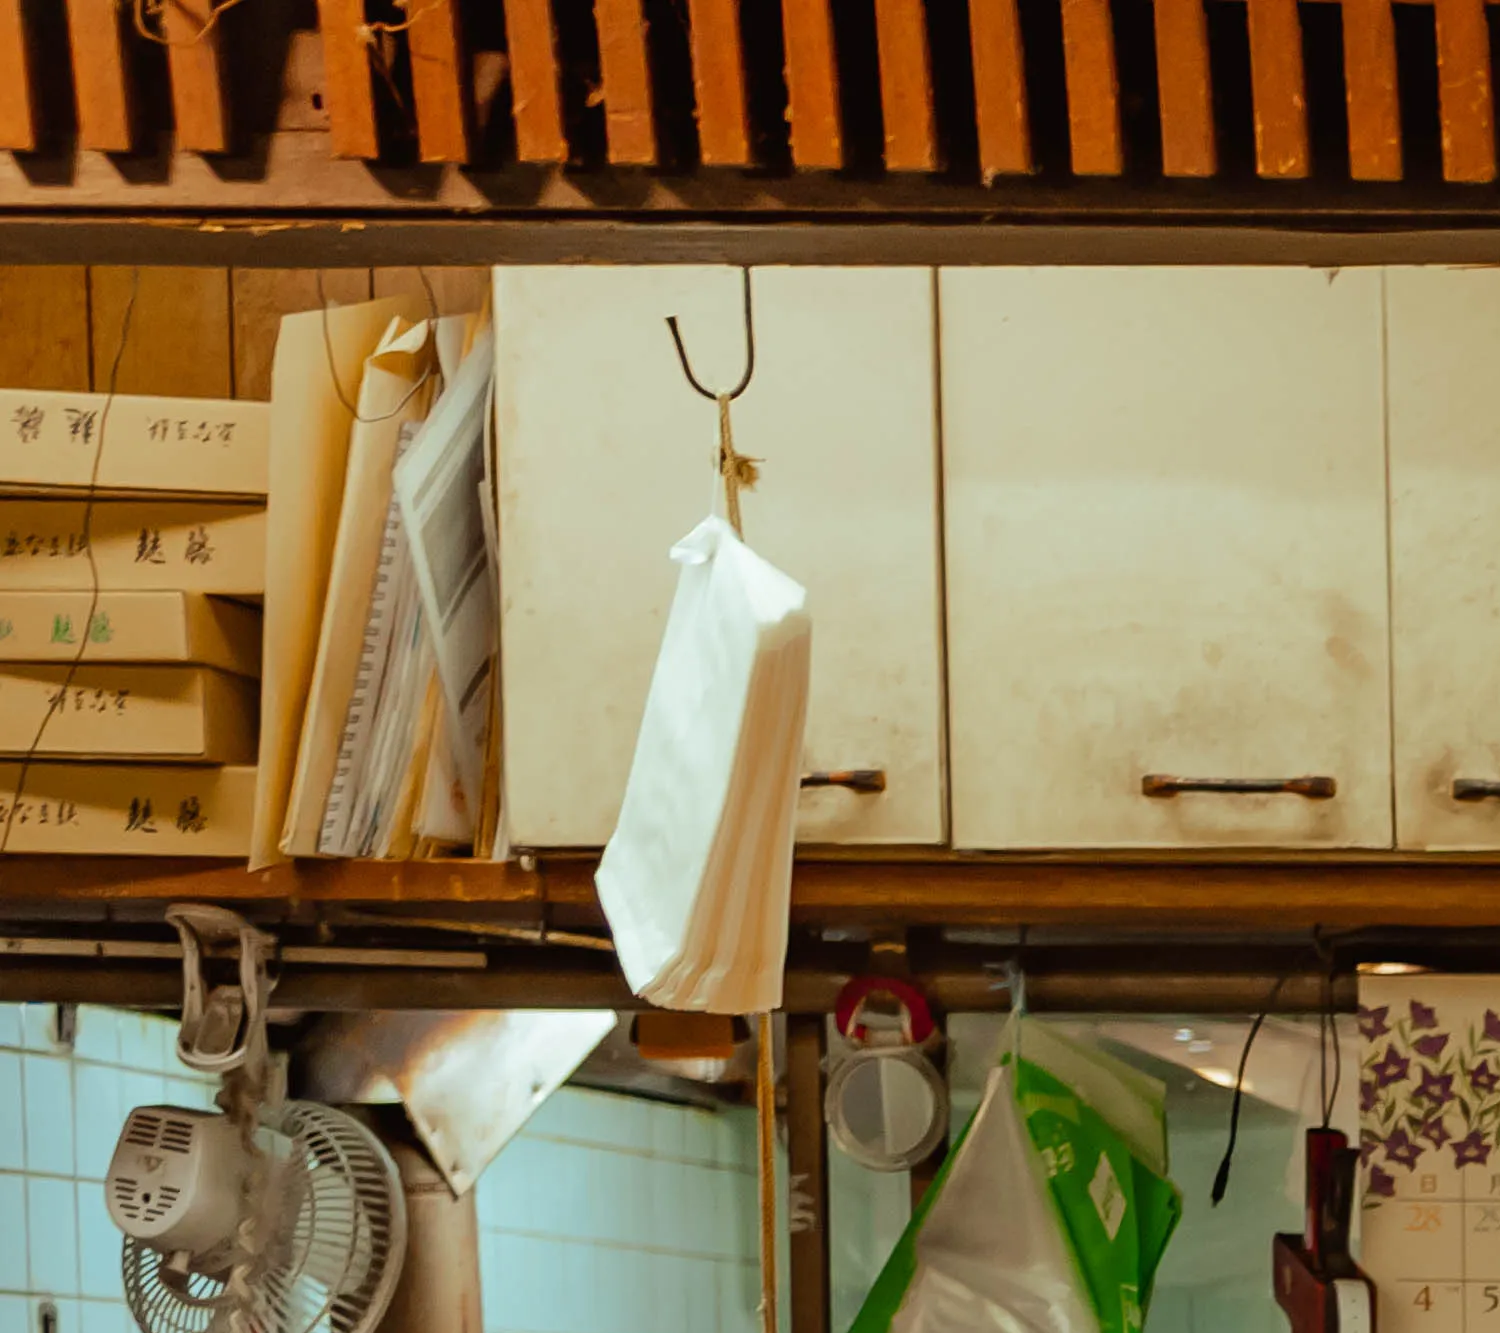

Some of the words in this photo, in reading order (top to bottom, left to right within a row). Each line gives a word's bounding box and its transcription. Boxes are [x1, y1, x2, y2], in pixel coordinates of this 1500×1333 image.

[1421, 1175, 1437, 1193] 日
[1405, 1204, 1443, 1232] 28
[1414, 1286, 1434, 1311] 4
[1483, 1286, 1499, 1314] 5
